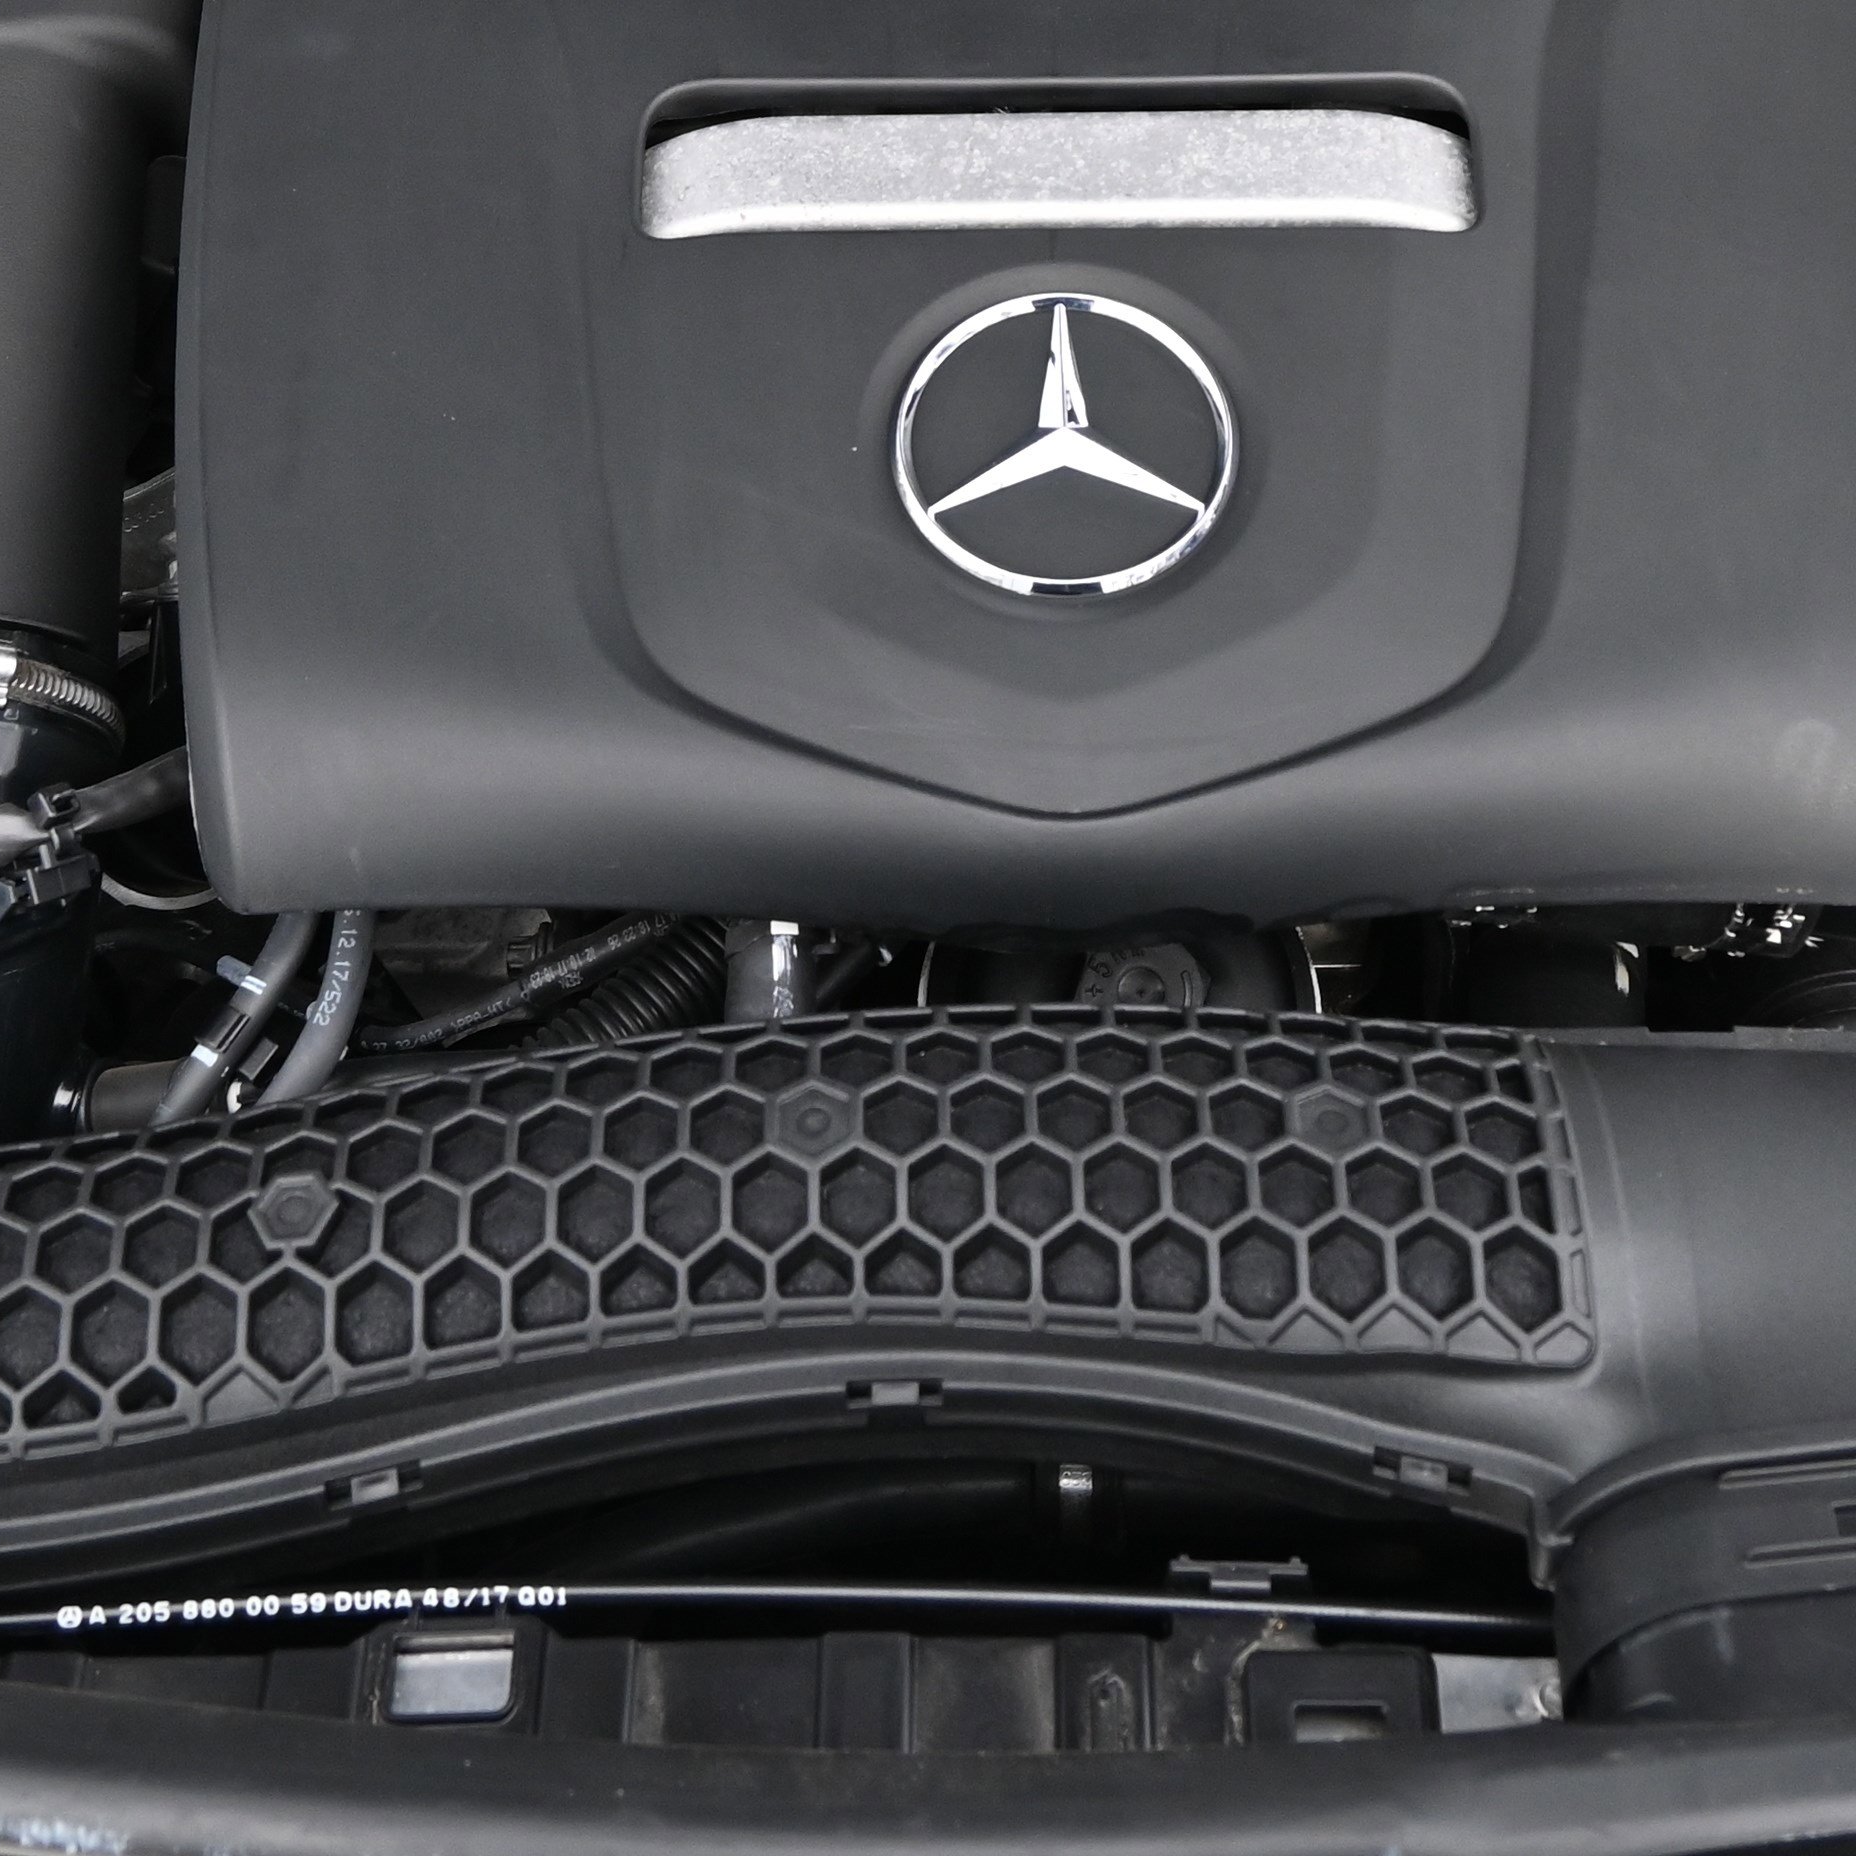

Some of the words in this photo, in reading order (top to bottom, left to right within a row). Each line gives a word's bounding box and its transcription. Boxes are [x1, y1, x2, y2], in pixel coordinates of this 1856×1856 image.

[89, 1605, 107, 1624] A
[119, 1600, 171, 1625] 205
[183, 1598, 235, 1621] 880
[246, 1595, 281, 1617] 00
[291, 1592, 327, 1615] 59
[334, 1589, 414, 1612] DURA
[422, 1585, 511, 1609] 48/17
